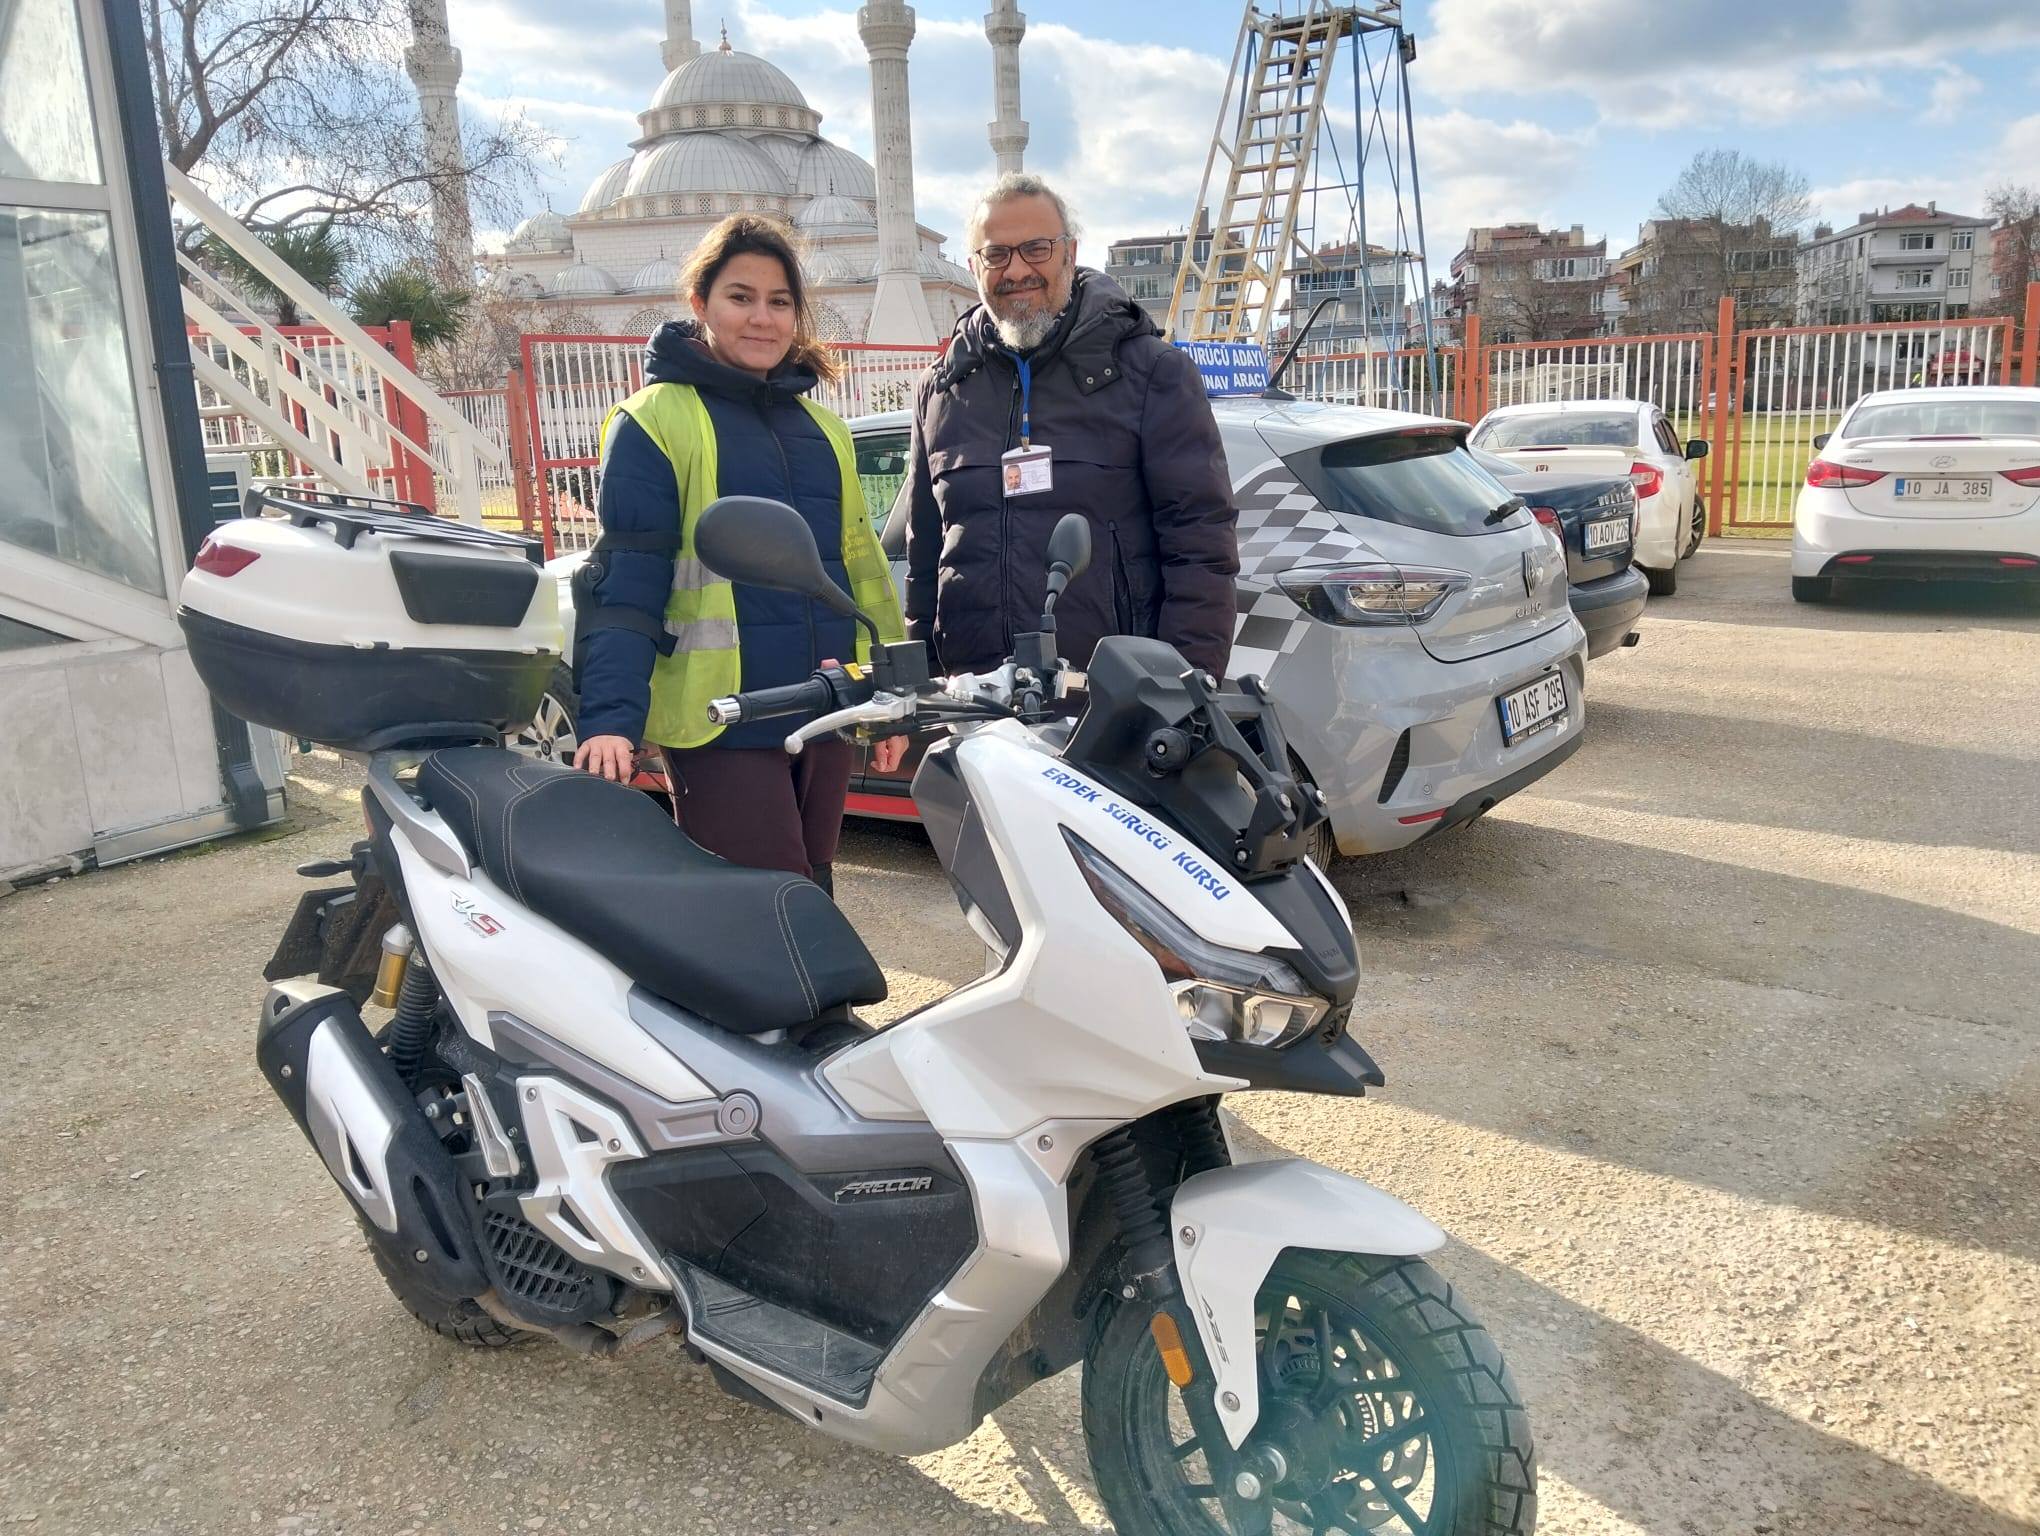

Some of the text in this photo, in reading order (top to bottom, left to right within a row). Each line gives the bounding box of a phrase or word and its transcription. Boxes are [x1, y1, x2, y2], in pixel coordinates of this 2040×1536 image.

[1233, 348, 1265, 367] ADAYI
[1201, 372, 1268, 390] INAV ARACI
[1907, 481, 1989, 496] 10 JA 385
[1589, 525, 1598, 547] 10
[1599, 522, 1615, 544] AOV
[1508, 678, 1564, 730] 10 ASF 295
[1041, 767, 1230, 901] ERDEK SÜRÜCÜ KURSU
[835, 1177, 932, 1205] FRECCIA
